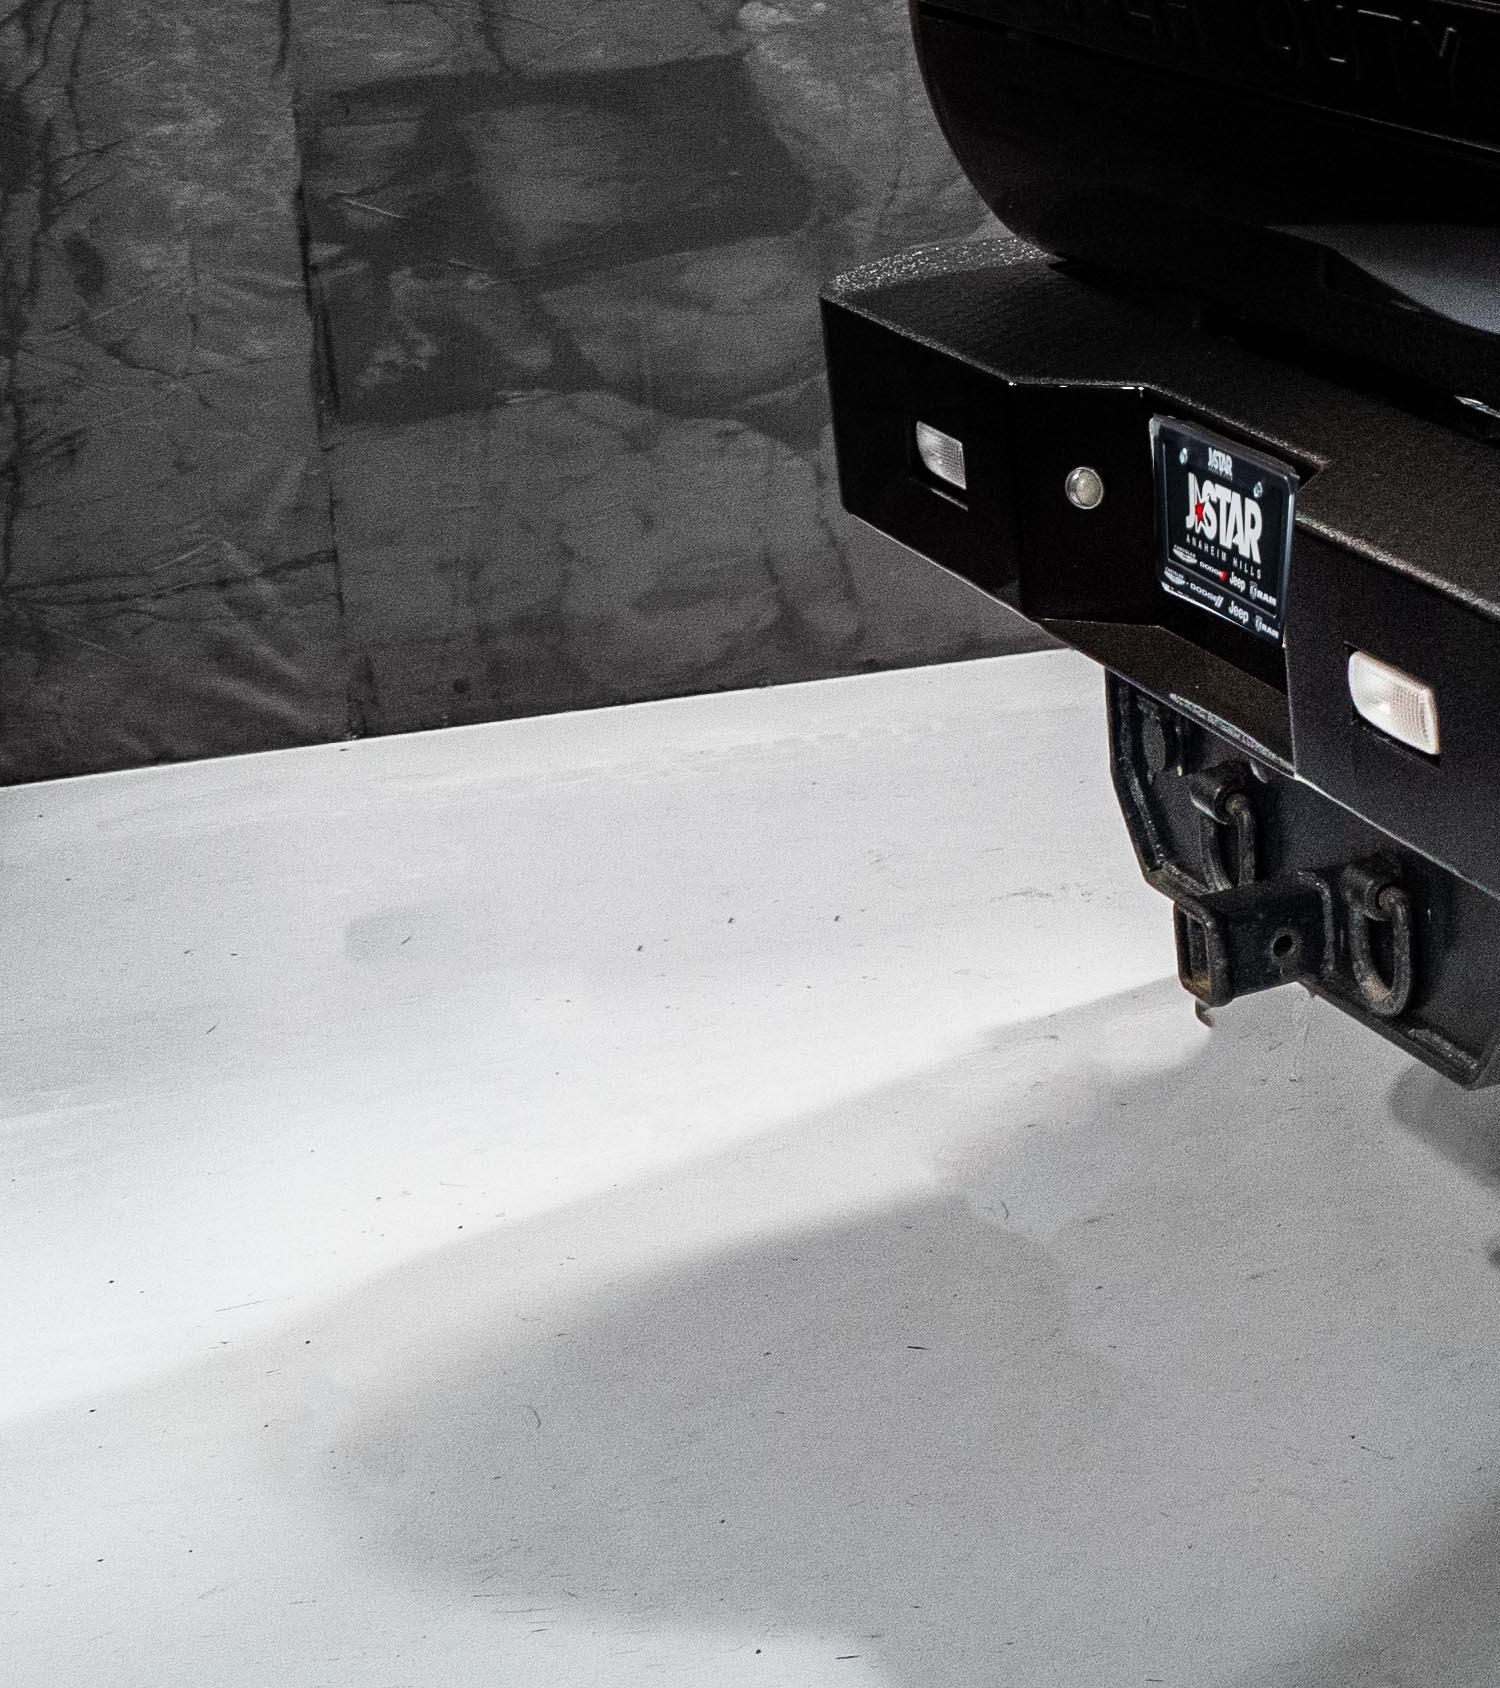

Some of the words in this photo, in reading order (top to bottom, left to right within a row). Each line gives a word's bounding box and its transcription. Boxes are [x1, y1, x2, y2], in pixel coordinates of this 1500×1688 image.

[1185, 534, 1227, 562] ANAHEIM
[1232, 557, 1262, 580] HILLS
[1190, 583, 1218, 602] DODGE
[1228, 600, 1249, 624] Jeep
[1261, 625, 1279, 639] RAM
[1229, 571, 1246, 592] Jeep
[1256, 590, 1277, 606] RAM
